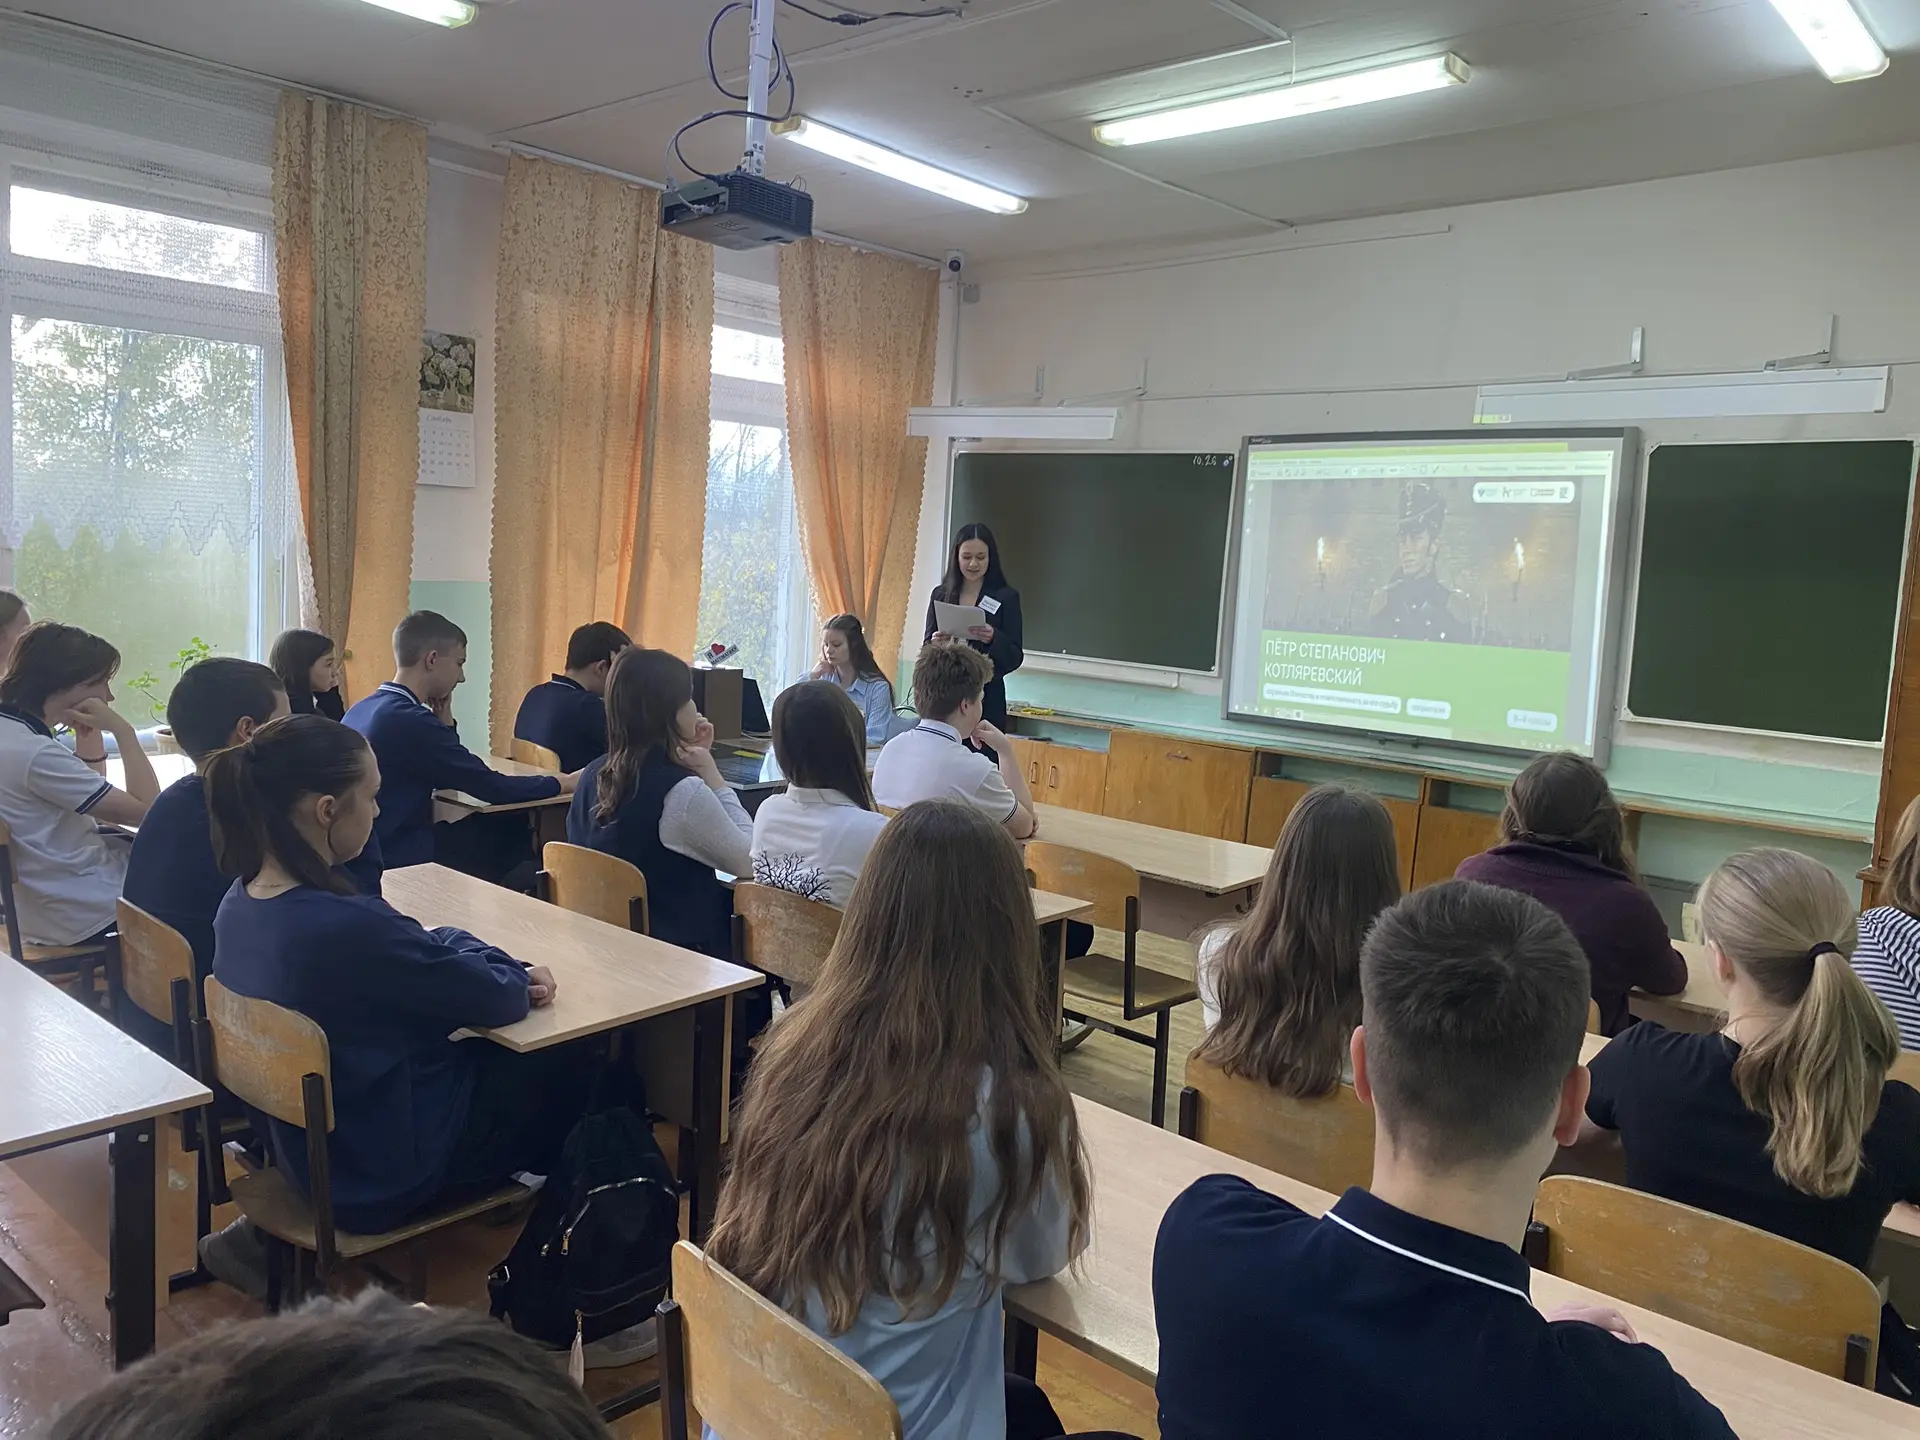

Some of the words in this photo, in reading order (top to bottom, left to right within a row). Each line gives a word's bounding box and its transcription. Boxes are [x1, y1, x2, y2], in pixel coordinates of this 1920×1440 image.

[1265, 637, 1297, 658] ПЁТР
[1299, 642, 1386, 665] СТЕПАНОВИЧ
[1264, 661, 1362, 686] КОТЛЯРЕВСКИЙ
